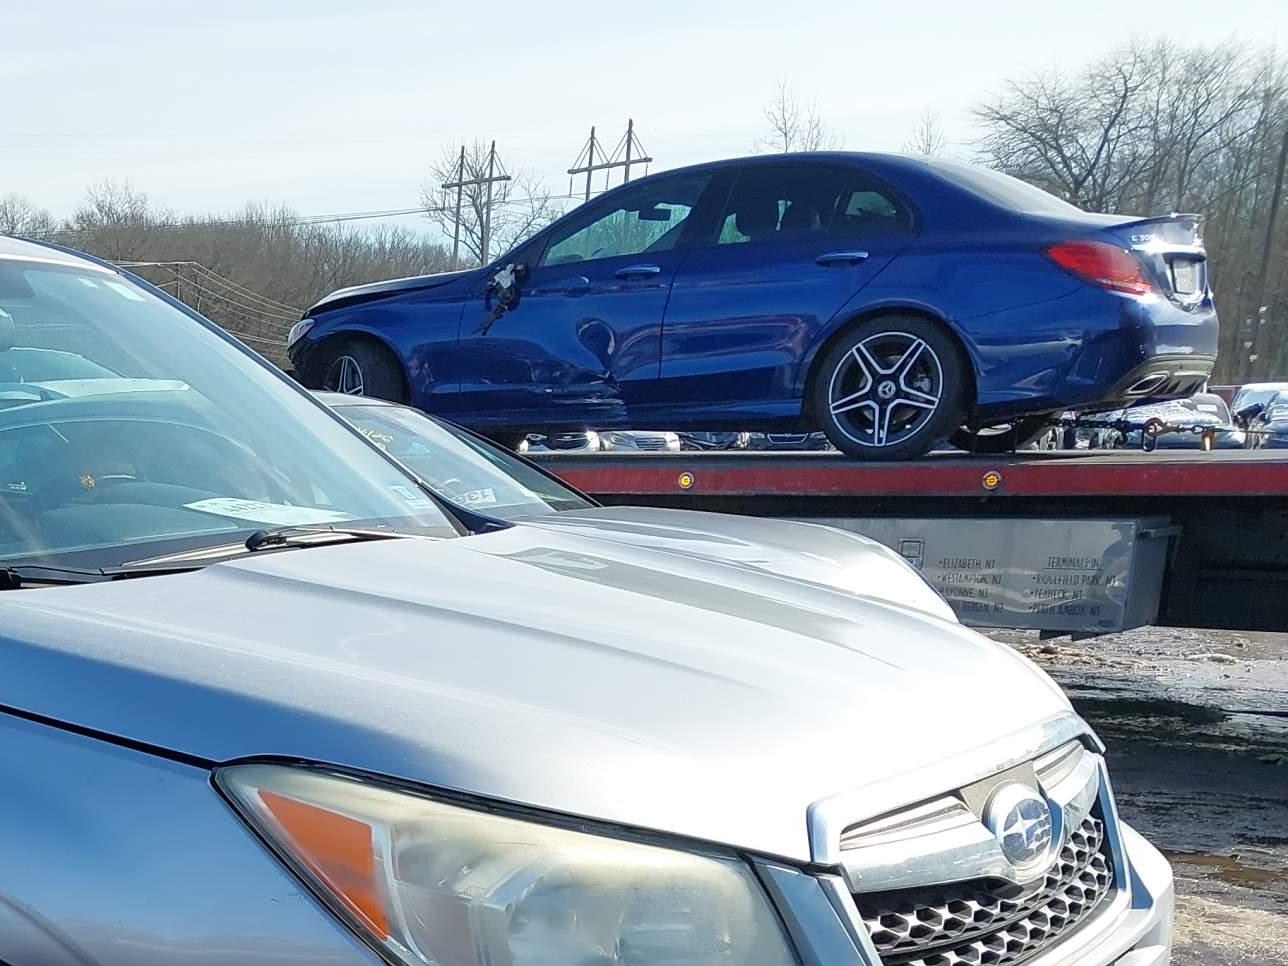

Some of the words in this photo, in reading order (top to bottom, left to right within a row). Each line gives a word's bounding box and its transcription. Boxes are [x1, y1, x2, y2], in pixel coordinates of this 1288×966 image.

[985, 559, 995, 569] NJ
[992, 575, 1002, 585] NJ
[978, 588, 988, 598] NJ
[1072, 590, 1082, 600] NJ
